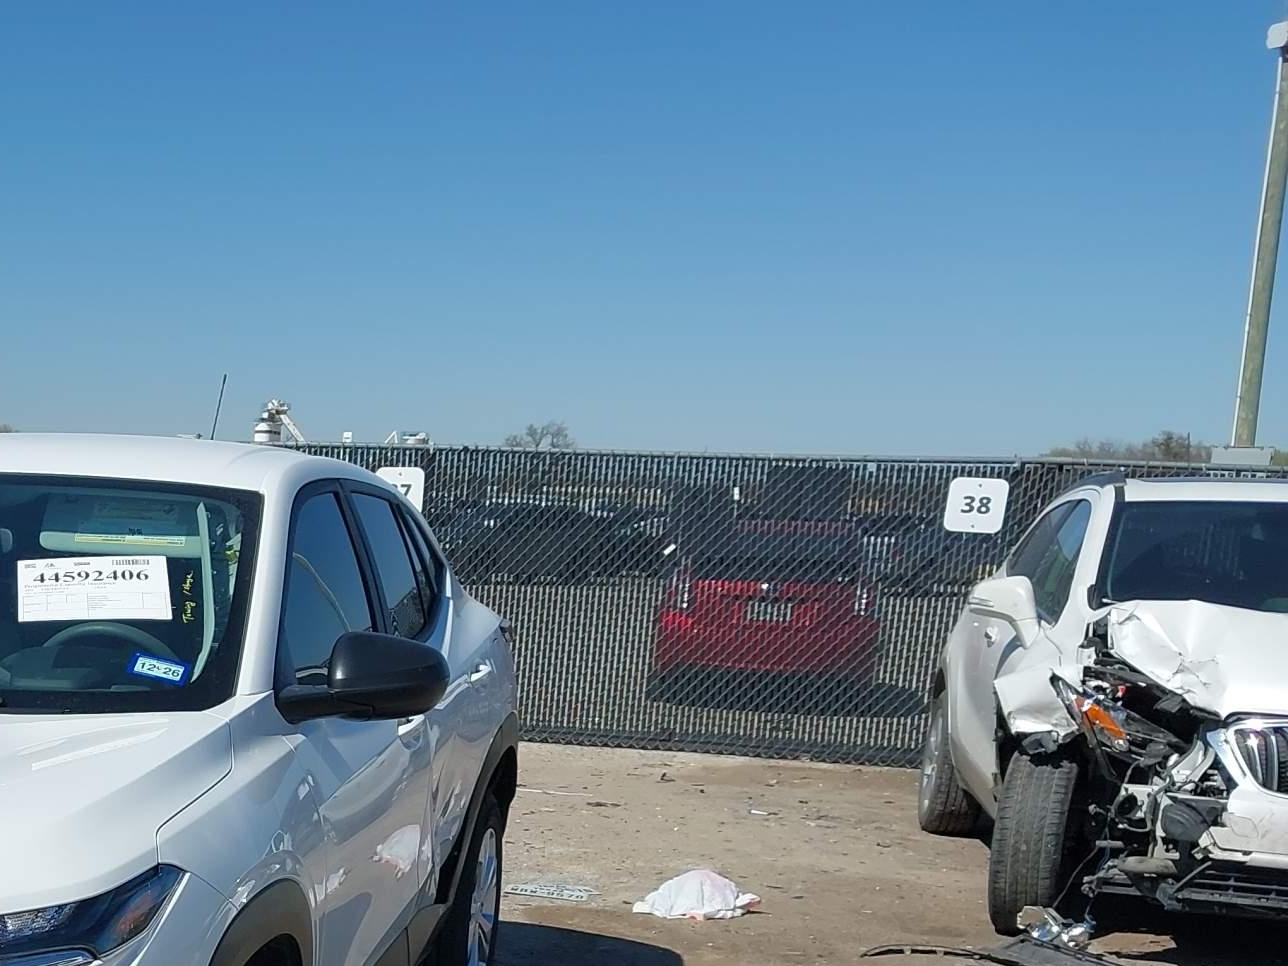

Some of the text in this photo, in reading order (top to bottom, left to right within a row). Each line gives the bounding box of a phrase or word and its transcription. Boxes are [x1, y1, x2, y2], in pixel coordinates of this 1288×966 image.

[392, 483, 411, 497] 7
[960, 496, 991, 514] 38
[33, 569, 149, 583] 44592406
